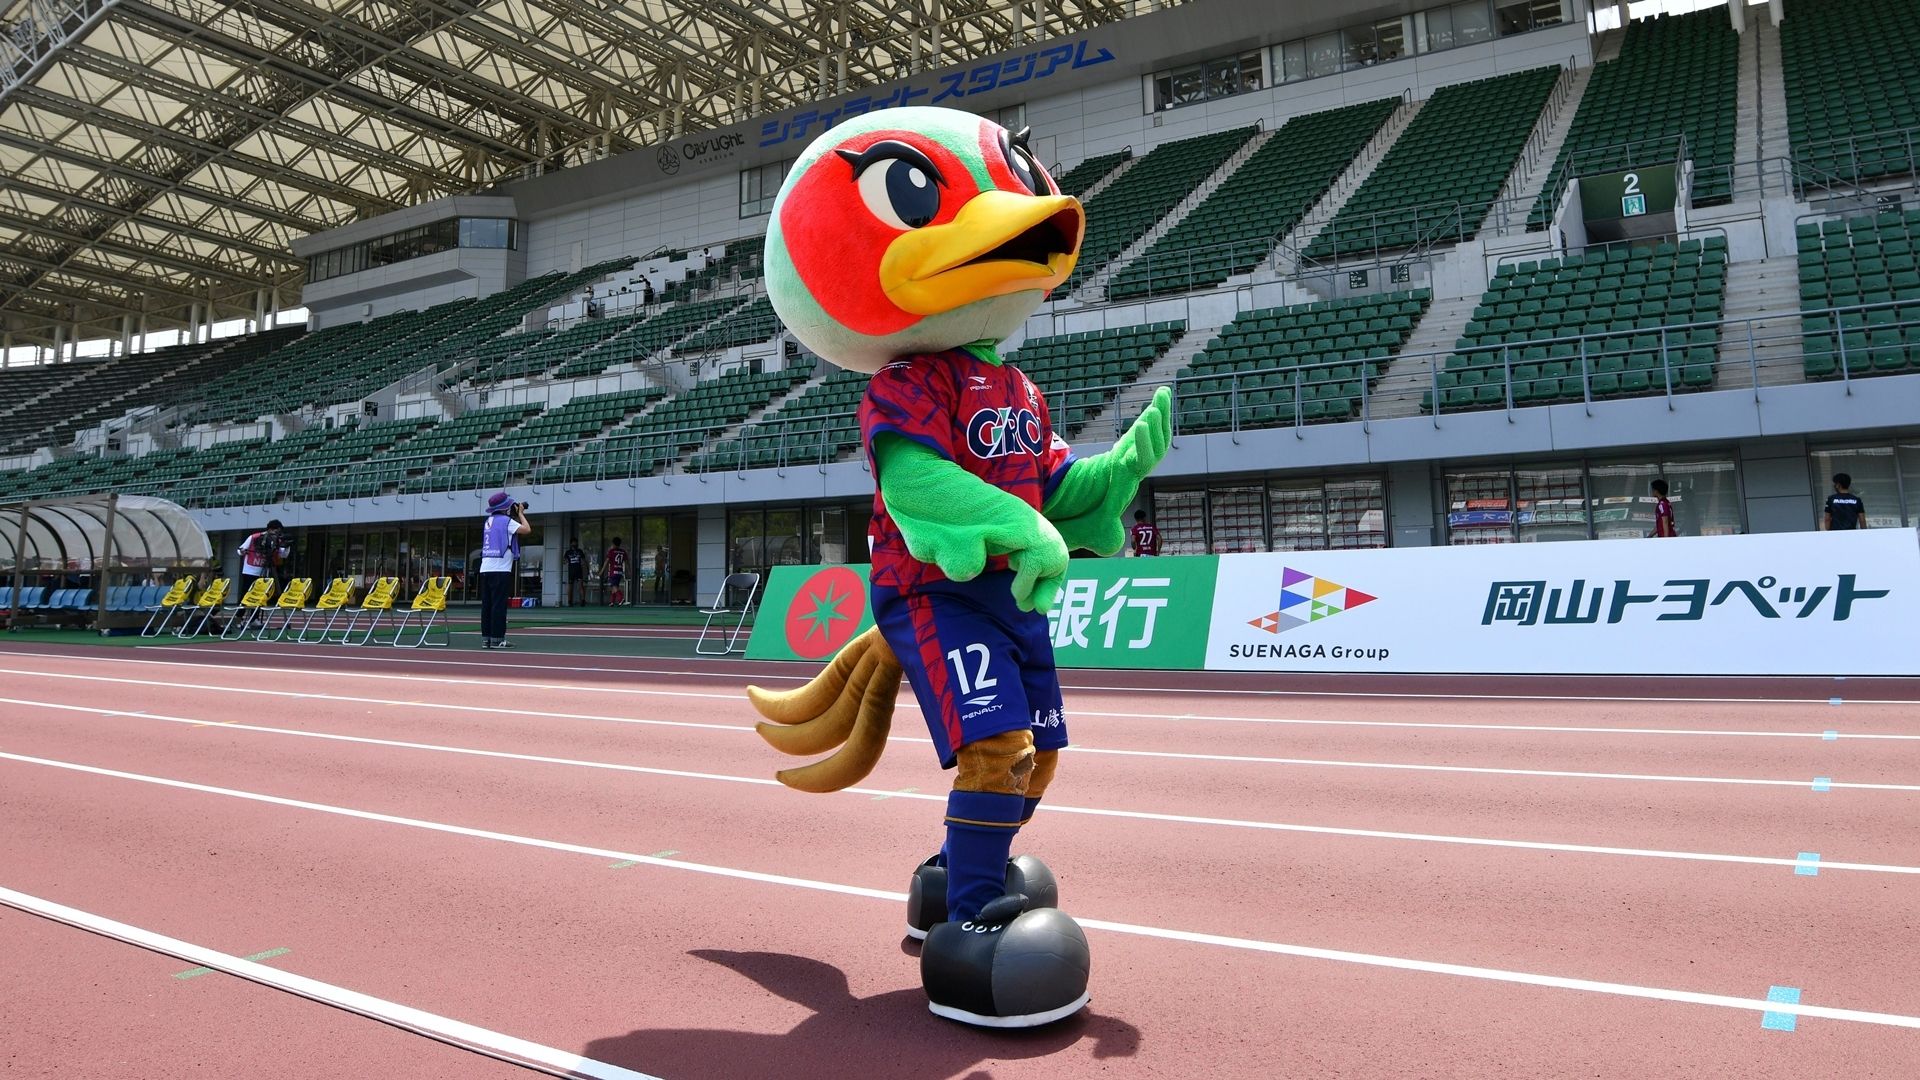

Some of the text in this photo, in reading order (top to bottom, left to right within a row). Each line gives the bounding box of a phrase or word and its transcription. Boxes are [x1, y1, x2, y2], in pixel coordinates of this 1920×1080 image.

[931, 39, 1116, 105] スタジアム
[1623, 173, 1640, 194] 2
[966, 406, 1044, 460] GRO
[1138, 530, 1153, 546] 27
[1046, 577, 1171, 649] 銀行
[1481, 573, 1892, 626] 岡山トヨペット
[947, 642, 998, 695] 12
[1229, 644, 1390, 661] SUENAGA Group
[961, 704, 1004, 721] PENALTY
